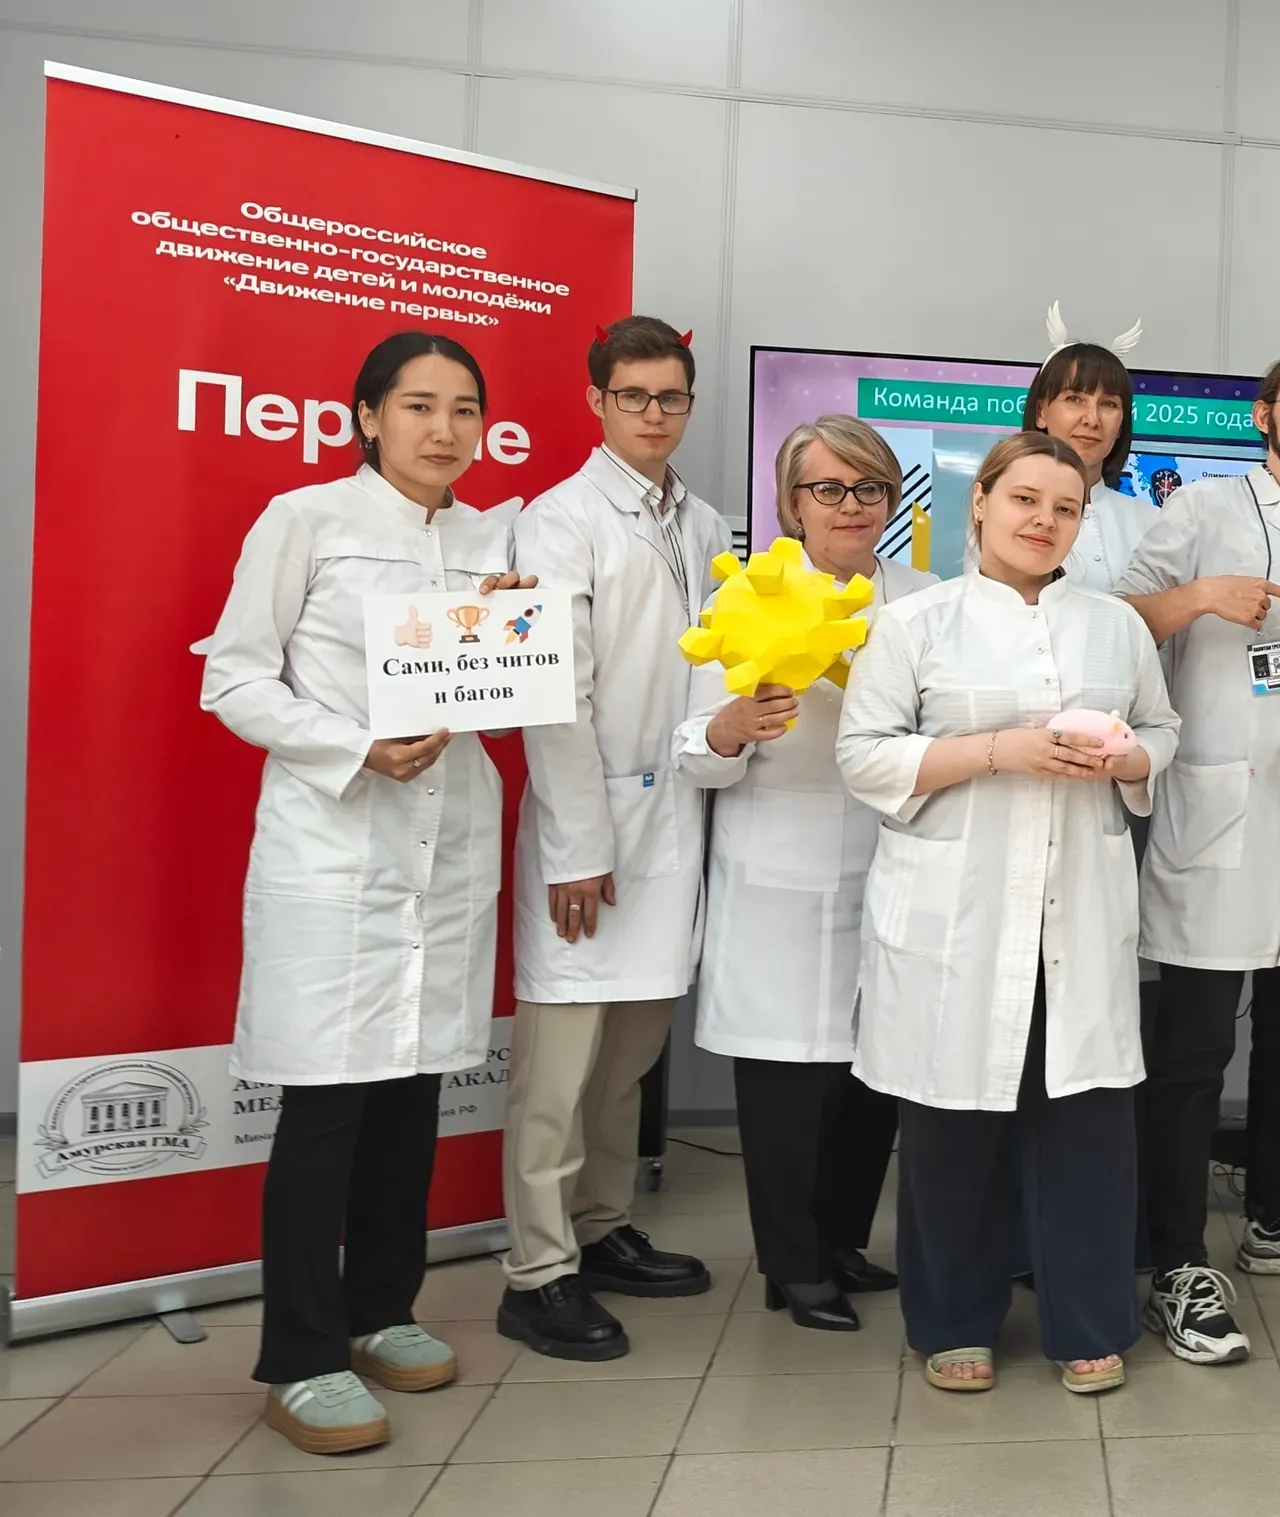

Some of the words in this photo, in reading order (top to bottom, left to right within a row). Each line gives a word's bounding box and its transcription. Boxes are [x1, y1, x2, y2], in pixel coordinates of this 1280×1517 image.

[131, 210, 570, 297] общественно-государственное
[240, 202, 487, 260] Общероссийское
[155, 239, 309, 275] движение
[313, 265, 396, 290] детей
[401, 278, 418, 293] и
[422, 282, 552, 315] молодёжи
[223, 273, 386, 311] «Движение
[390, 299, 500, 326] первых»
[177, 367, 532, 466] Пере
[873, 386, 979, 415] Команда
[1145, 403, 1199, 425] 2025
[1206, 410, 1254, 432] года
[382, 658, 451, 677] Сами,
[456, 653, 489, 672] без
[496, 652, 560, 668] читов
[434, 691, 448, 704] и
[454, 685, 514, 703] багов
[56, 1139, 147, 1163] Амурская
[152, 1136, 190, 1149] ГМА
